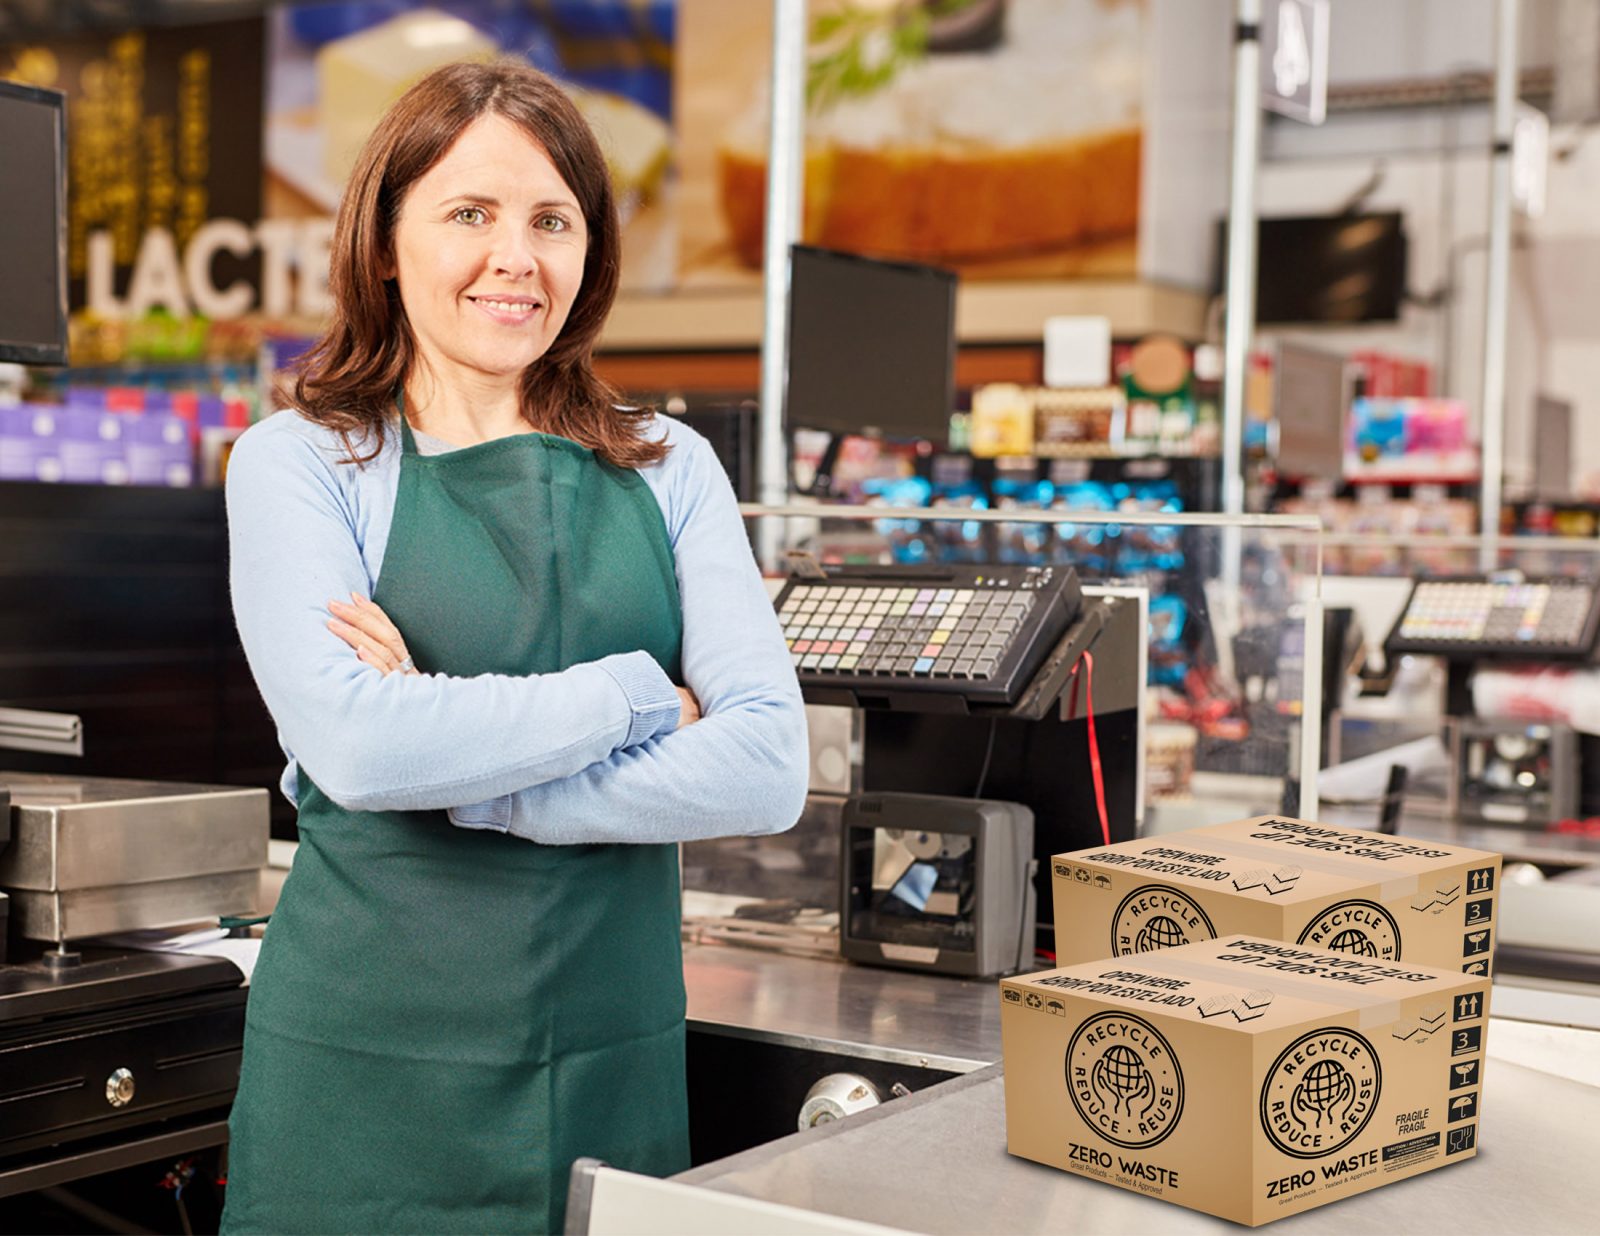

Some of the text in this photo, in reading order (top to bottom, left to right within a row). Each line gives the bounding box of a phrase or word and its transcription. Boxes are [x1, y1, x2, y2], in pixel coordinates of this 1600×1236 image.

[1250, 832, 1403, 861] THIS SIDE UP
[1258, 819, 1452, 858] ESTE LADO ARRIBA
[1080, 852, 1231, 881] ABRIR POR ESTE LADO
[1141, 847, 1226, 866] OPEN HERE
[1130, 895, 1200, 929] RECYCLE
[1311, 910, 1382, 943] RECYCLE
[1470, 904, 1481, 919] 3
[1216, 954, 1384, 985] THIS SIDE UP
[1225, 940, 1438, 982] ESTE LADO ARRIBA
[1031, 976, 1196, 1007] ABRIR POR ESTE LADO
[1098, 970, 1191, 991] OPEN HERE
[1086, 1023, 1161, 1059] RECYCLE
[1283, 1039, 1360, 1075] RECYCLE
[1457, 1032, 1469, 1049] 3
[1075, 1067, 1119, 1134] REDUCE
[1138, 1086, 1174, 1136] REUSE
[1340, 1078, 1372, 1134] REUSE
[1395, 1108, 1429, 1125] FRAGILE
[1272, 1101, 1322, 1147] REDUCE
[1398, 1120, 1426, 1136] FRAGIL
[1068, 1142, 1179, 1188] ZERO WASTE
[1085, 1165, 1107, 1178] Products
[1115, 1174, 1132, 1186] Tested
[1138, 1181, 1163, 1194] Approved
[1266, 1170, 1316, 1199] ZERO
[1321, 1149, 1378, 1179] WASTE
[1294, 1189, 1316, 1200] Products
[1324, 1179, 1343, 1190] Tested
[1350, 1167, 1378, 1181] Approved
